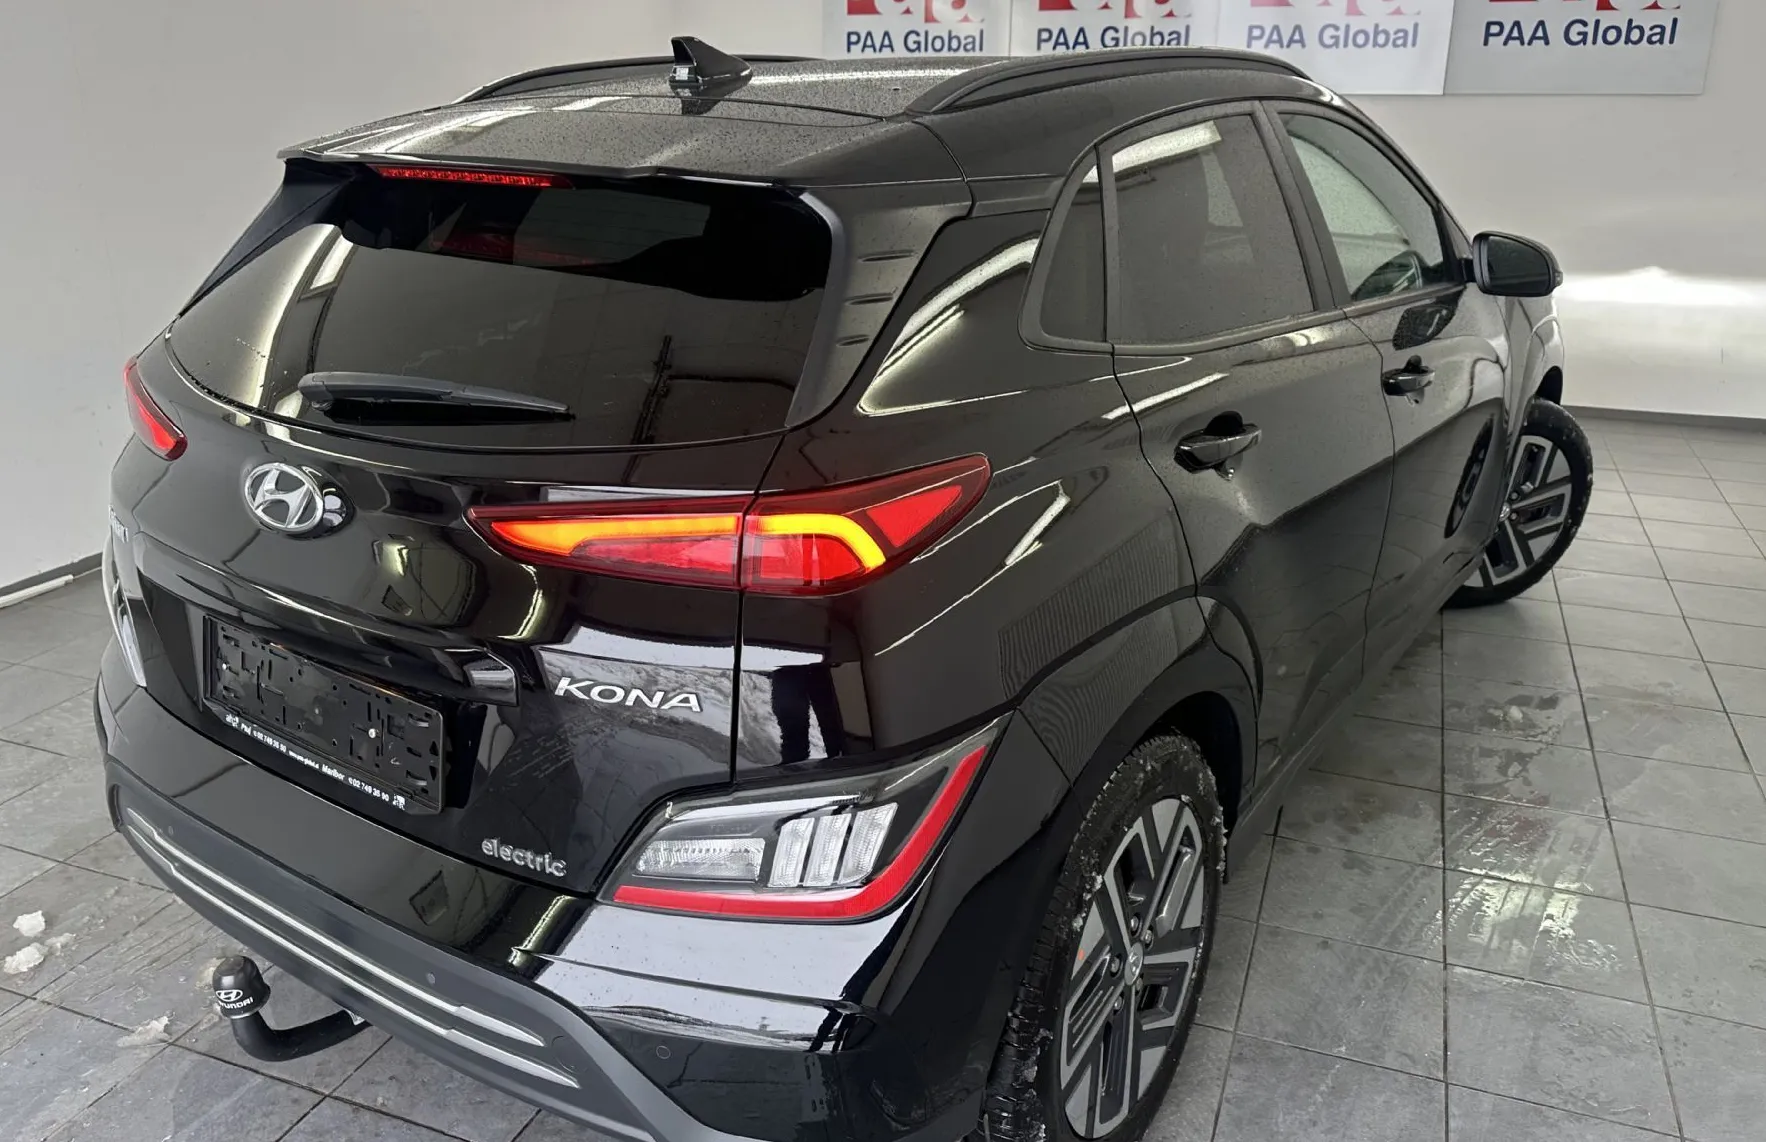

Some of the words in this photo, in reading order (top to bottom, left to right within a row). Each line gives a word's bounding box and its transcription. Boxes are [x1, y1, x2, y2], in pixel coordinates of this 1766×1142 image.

[846, 30, 894, 53] PAA
[903, 28, 984, 53] Global
[1037, 26, 1090, 51] PAA
[1100, 24, 1191, 49] Global
[1246, 24, 1307, 49] PAA
[1318, 22, 1420, 49] Global
[1483, 19, 1551, 46] PAA
[1563, 17, 1679, 46] Global
[554, 676, 702, 713] KONA
[321, 763, 346, 781] Maribor
[481, 837, 567, 877] electric
